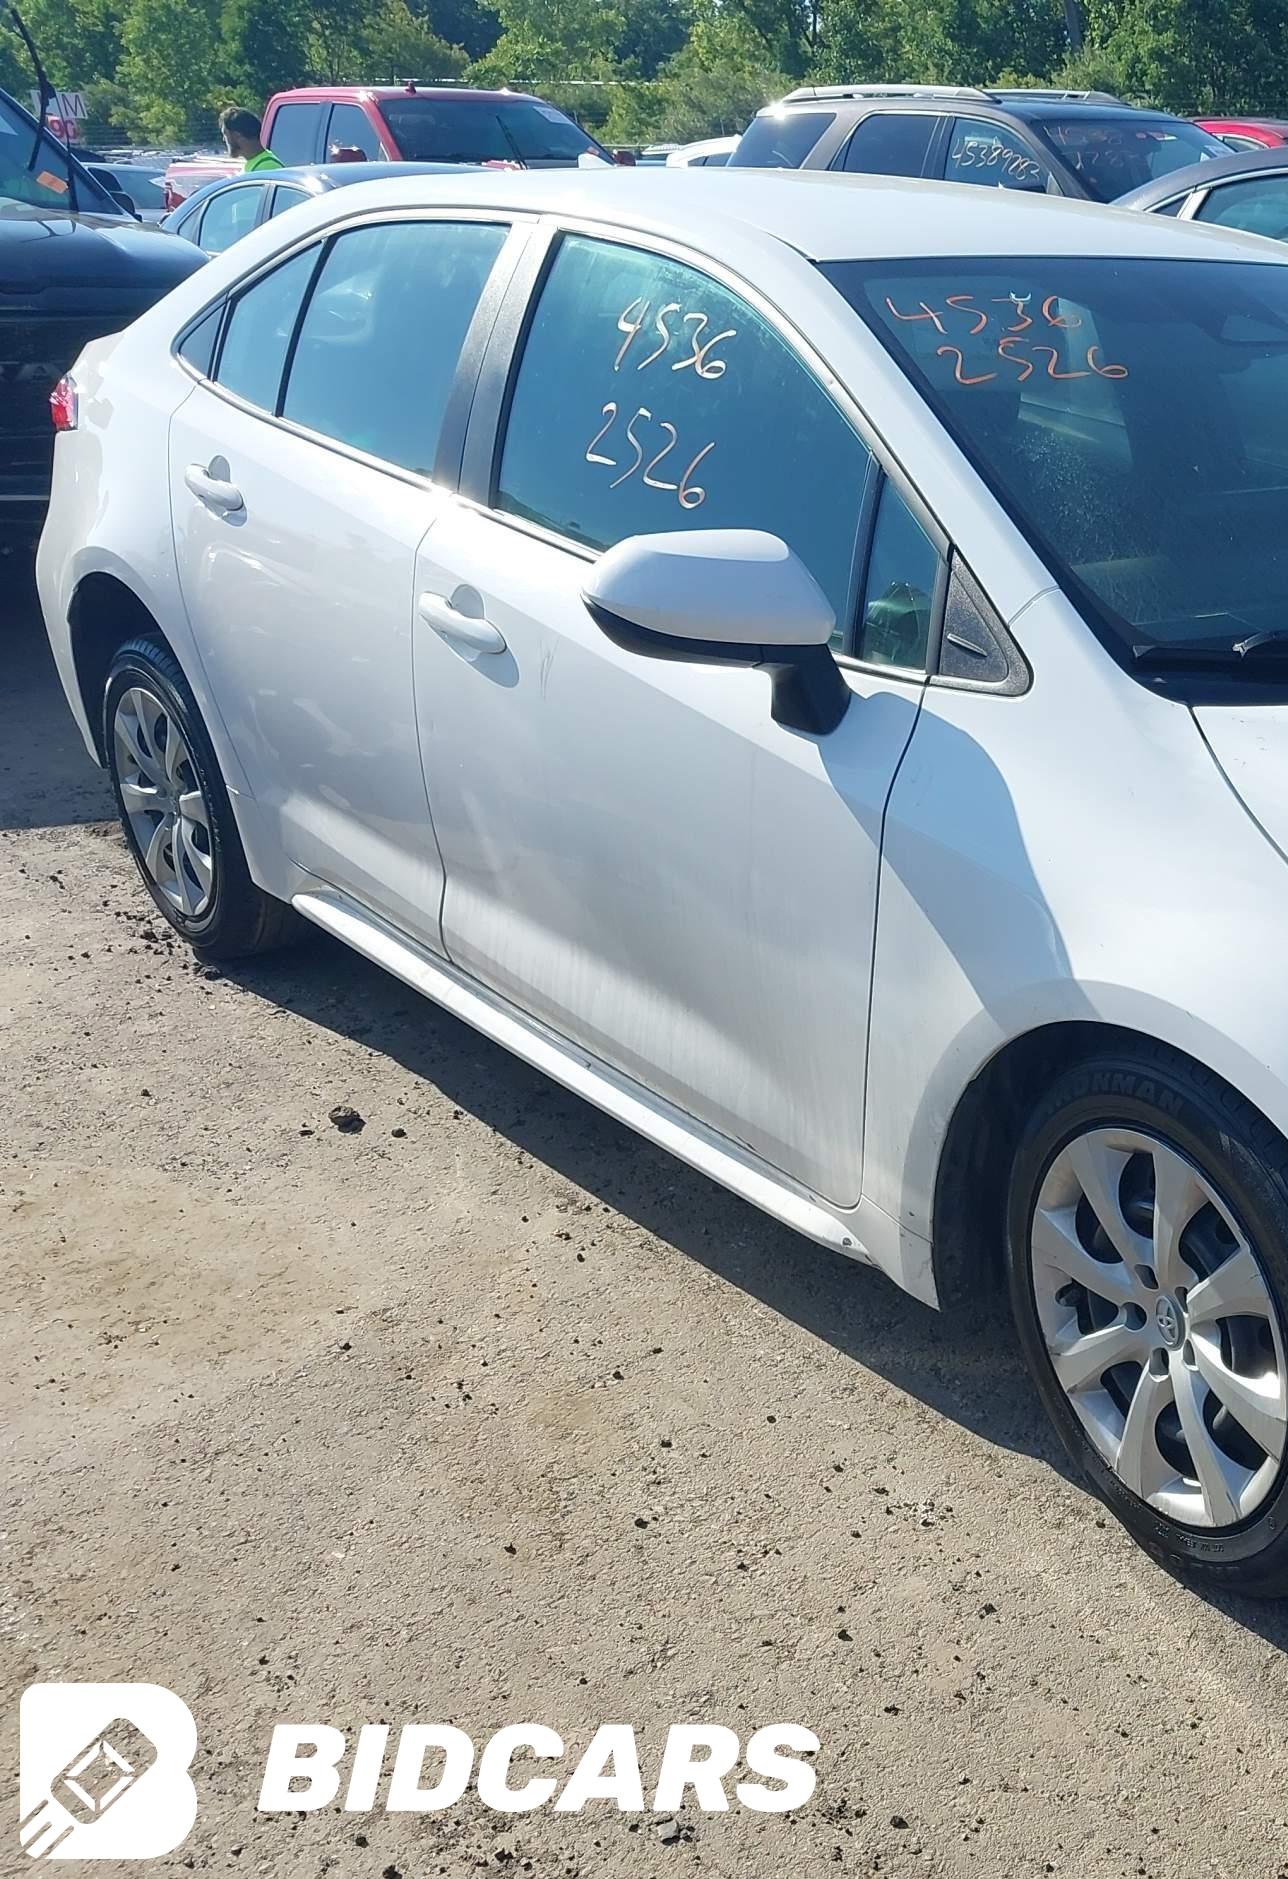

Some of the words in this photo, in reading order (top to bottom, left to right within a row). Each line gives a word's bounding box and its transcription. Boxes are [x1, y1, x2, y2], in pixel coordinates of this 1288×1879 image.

[613, 296, 737, 379] 4536
[886, 294, 1083, 335] 4536
[936, 336, 1129, 384] 2526
[585, 402, 716, 509] 2526
